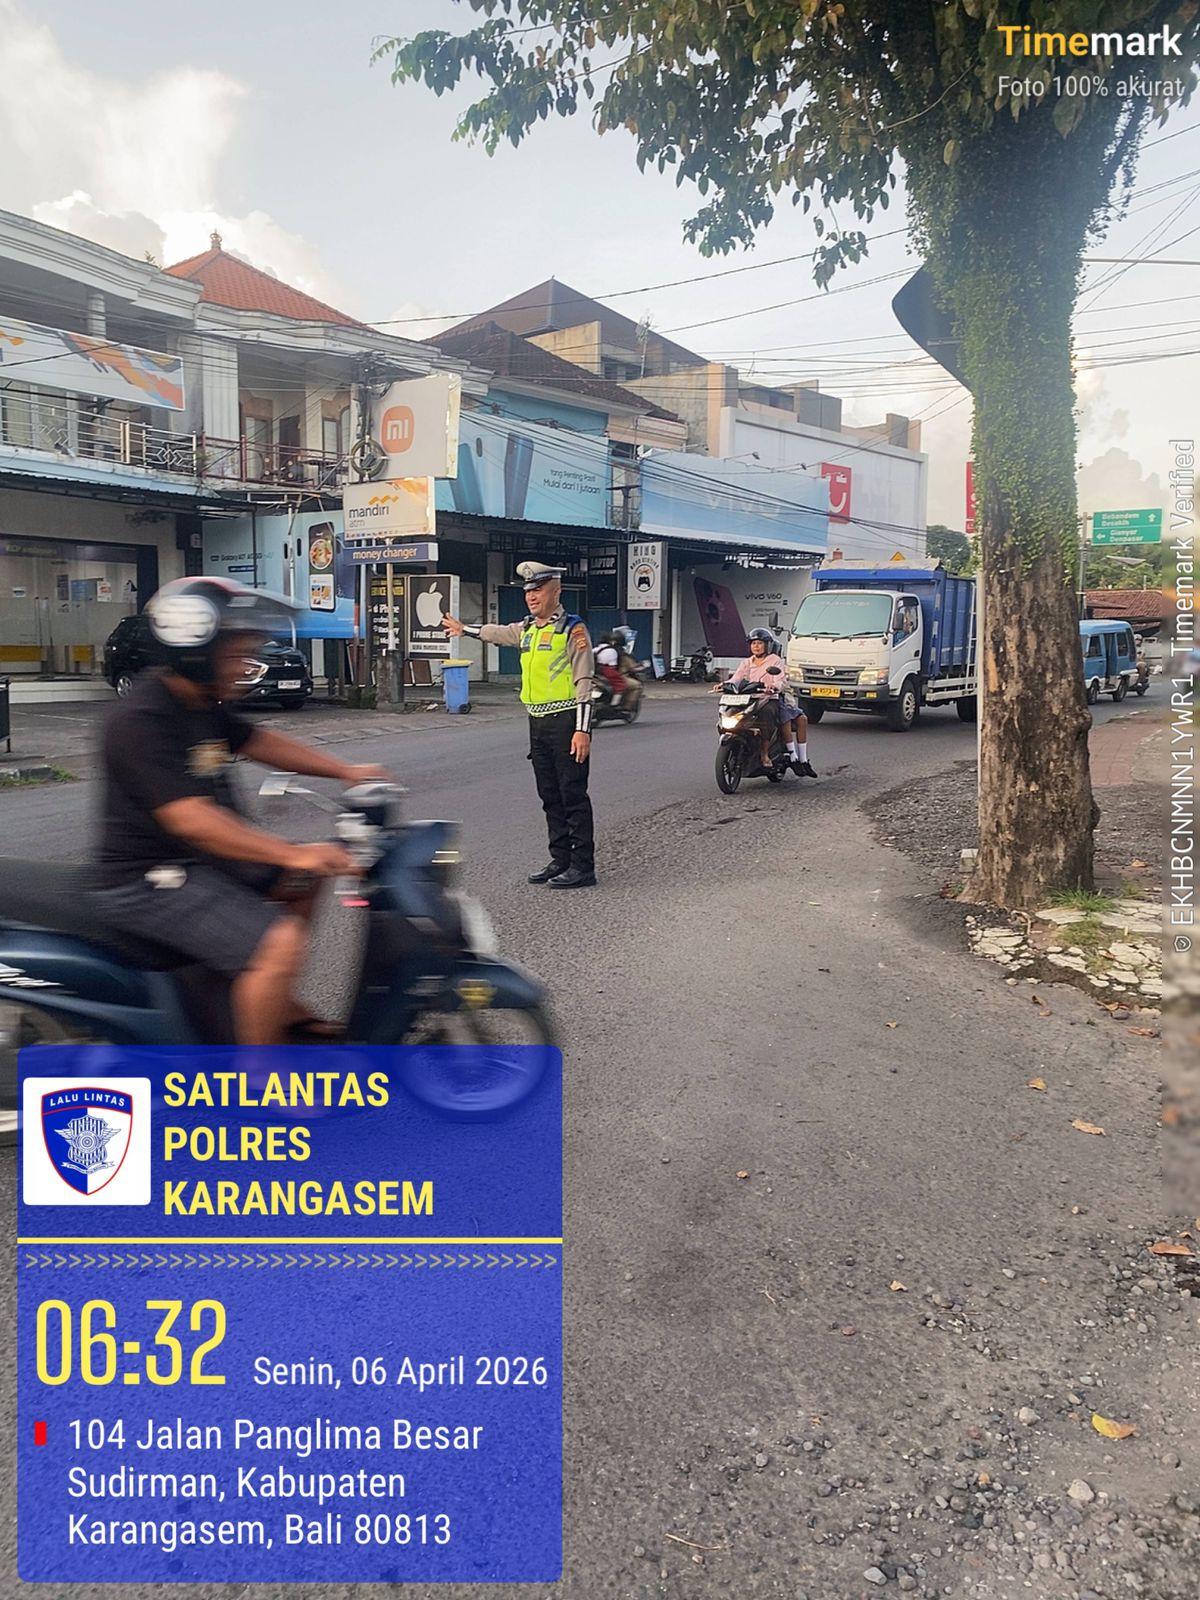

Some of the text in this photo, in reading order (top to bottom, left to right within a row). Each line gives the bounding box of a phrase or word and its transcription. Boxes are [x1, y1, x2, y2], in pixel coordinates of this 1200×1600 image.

[543, 478, 561, 489] Mulai
[561, 480, 576, 491] dari
[349, 503, 390, 519] mandiri
[349, 518, 366, 528] atm
[352, 547, 418, 563] money changer
[766, 592, 783, 600] V60
